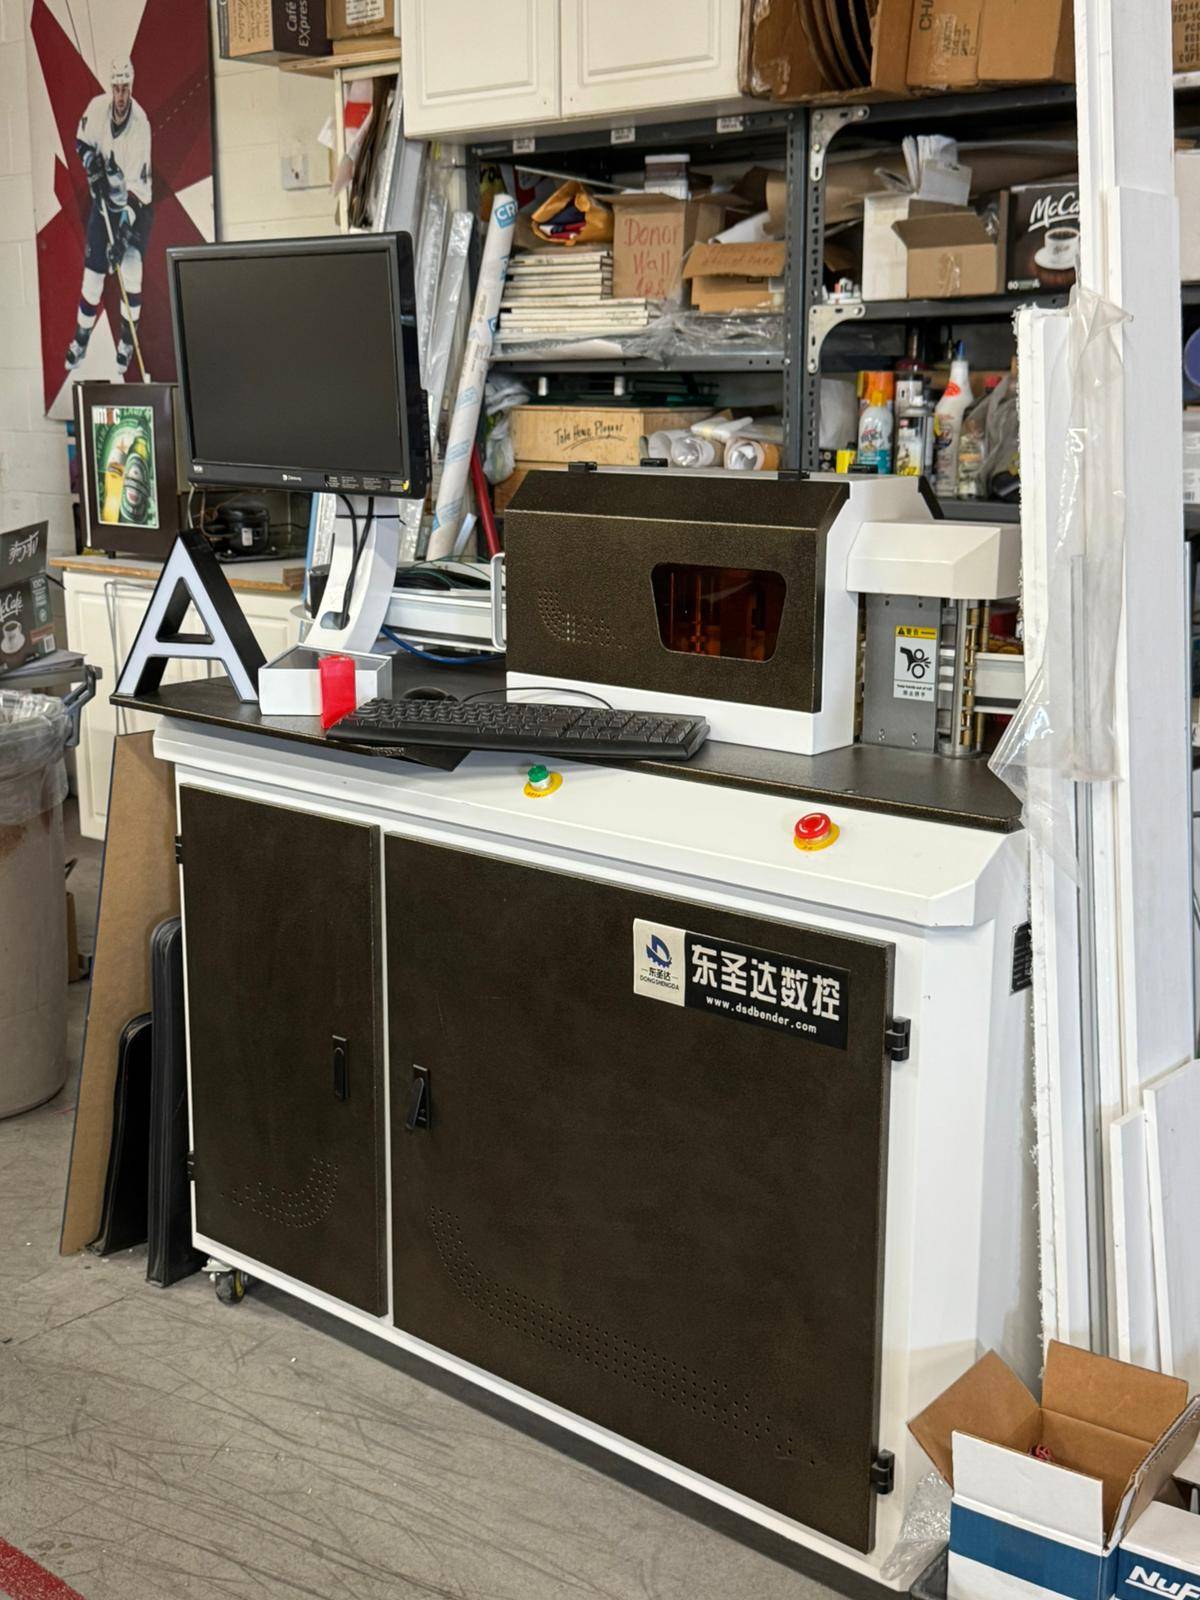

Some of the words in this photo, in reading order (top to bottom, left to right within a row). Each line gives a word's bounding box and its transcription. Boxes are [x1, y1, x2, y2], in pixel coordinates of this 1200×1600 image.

[286, 0, 298, 32] Café
[496, 202, 517, 221] CR
[623, 217, 679, 248] Donor
[633, 250, 671, 276] Wall
[115, 534, 259, 704] A
[691, 944, 840, 1021] 东圣达数控
[705, 995, 818, 1035] www.dsdbender.com
